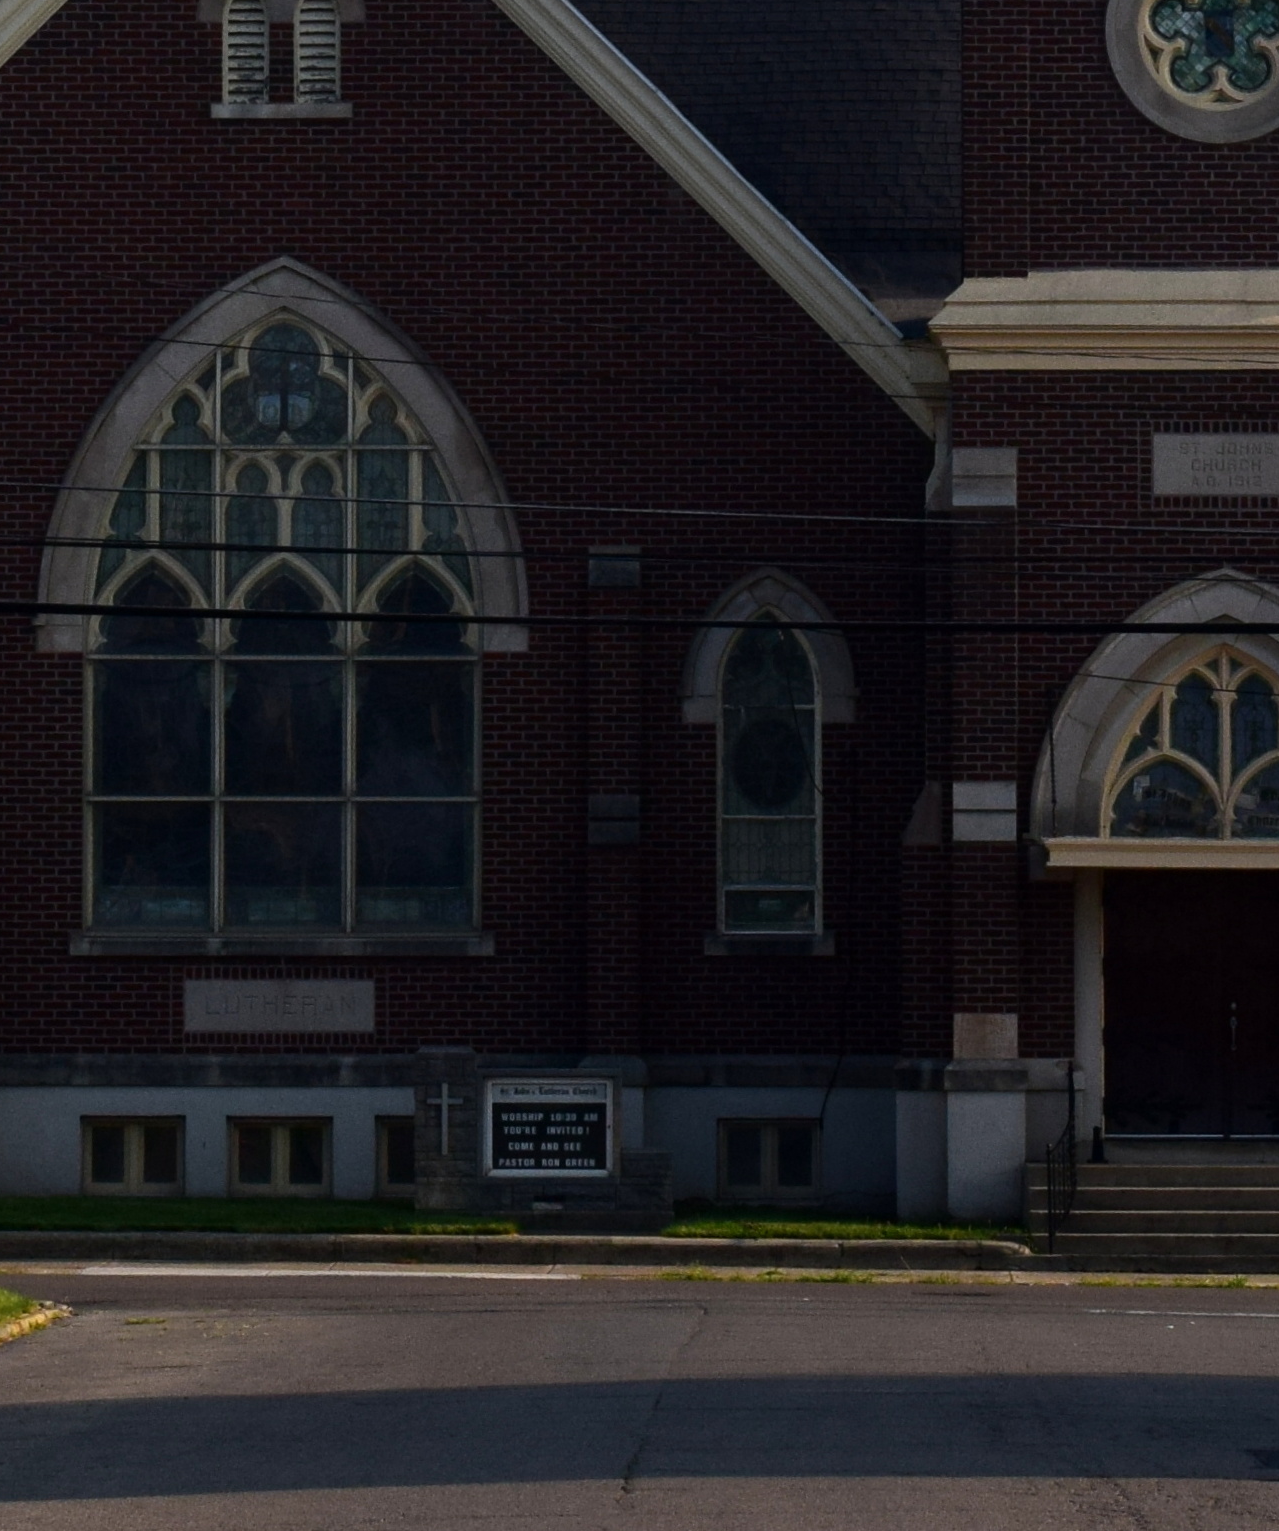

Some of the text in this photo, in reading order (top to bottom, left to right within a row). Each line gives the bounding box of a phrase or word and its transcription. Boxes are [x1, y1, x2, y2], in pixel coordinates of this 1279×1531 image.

[1191, 458, 1262, 472] CHURCH
[205, 994, 358, 1015] LUTHERAN
[572, 1086, 598, 1096] Church
[501, 1112, 599, 1122] WORSHIP 10:30 AM
[503, 1125, 537, 1135] YOU'RE
[507, 1141, 582, 1151] COME AND SEE
[498, 1158, 596, 1168] PASTOR RON GREEN
